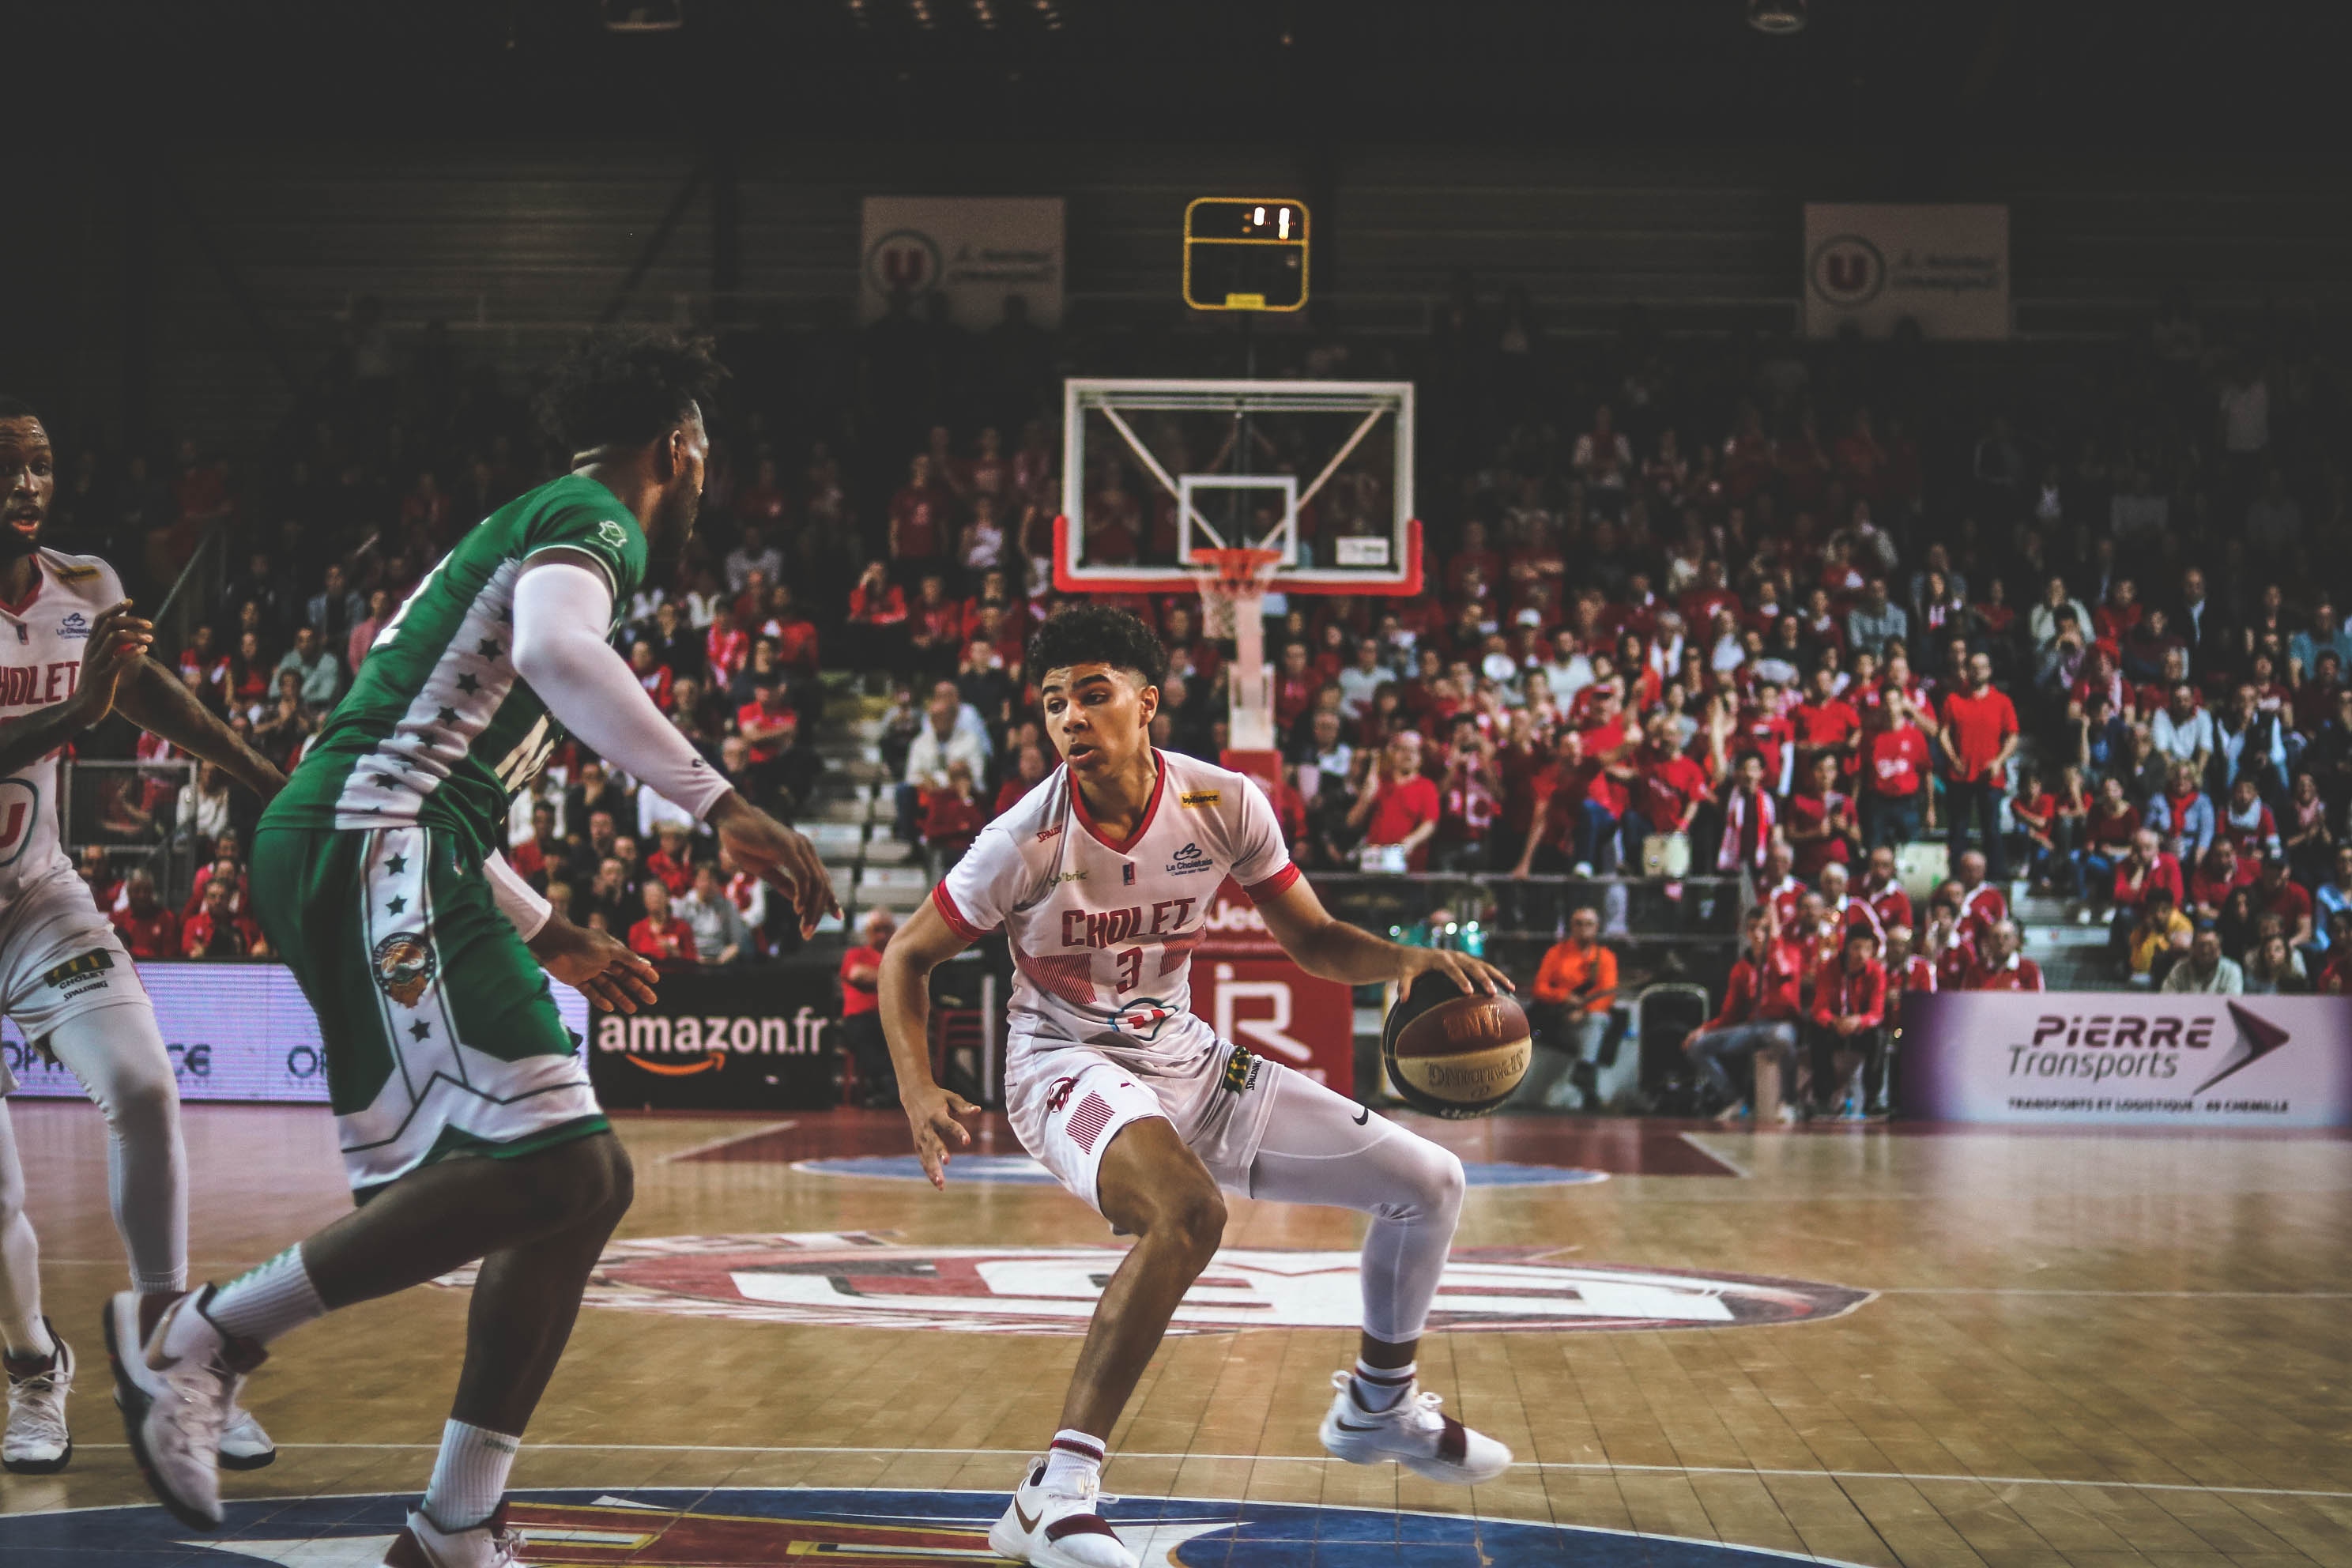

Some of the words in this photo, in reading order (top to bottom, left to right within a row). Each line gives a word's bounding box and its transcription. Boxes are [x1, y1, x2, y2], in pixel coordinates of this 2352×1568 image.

[1061, 897, 1197, 949] CHOLET
[1205, 899, 1266, 930] Jee
[1115, 945, 1144, 994] 3
[598, 1006, 828, 1054] amazon.fr
[1245, 1059, 1263, 1091] SPALDING
[2007, 1045, 2180, 1083] Transports
